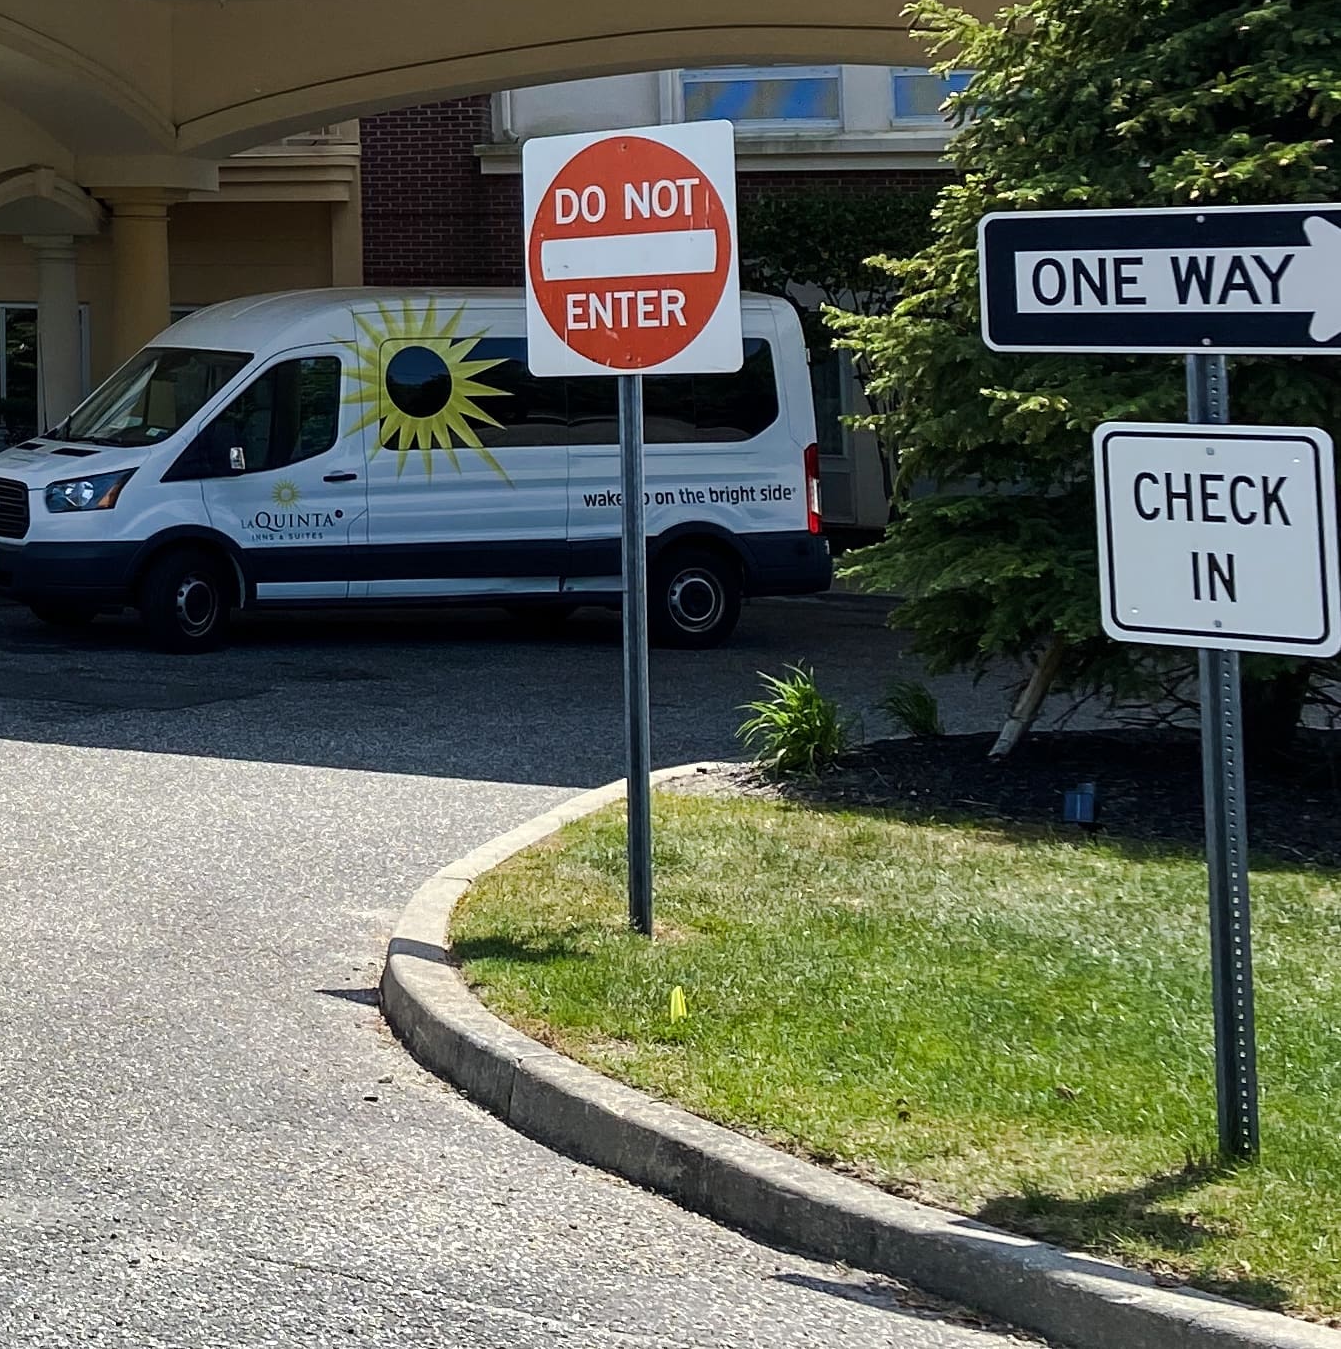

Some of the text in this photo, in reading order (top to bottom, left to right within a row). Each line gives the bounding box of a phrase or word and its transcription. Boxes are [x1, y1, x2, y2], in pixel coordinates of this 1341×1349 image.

[555, 178, 700, 225] DO NOT
[1031, 253, 1295, 307] ONE WAY
[566, 289, 687, 330] ENTER
[655, 491, 675, 505] on
[679, 488, 705, 504] the
[709, 485, 757, 506] bright
[760, 484, 792, 502] side
[1133, 471, 1291, 527] CHECK
[252, 533, 274, 541] INNS
[288, 532, 324, 540] SUITES
[255, 511, 334, 532] QUINTA
[1191, 551, 1237, 603] IN
